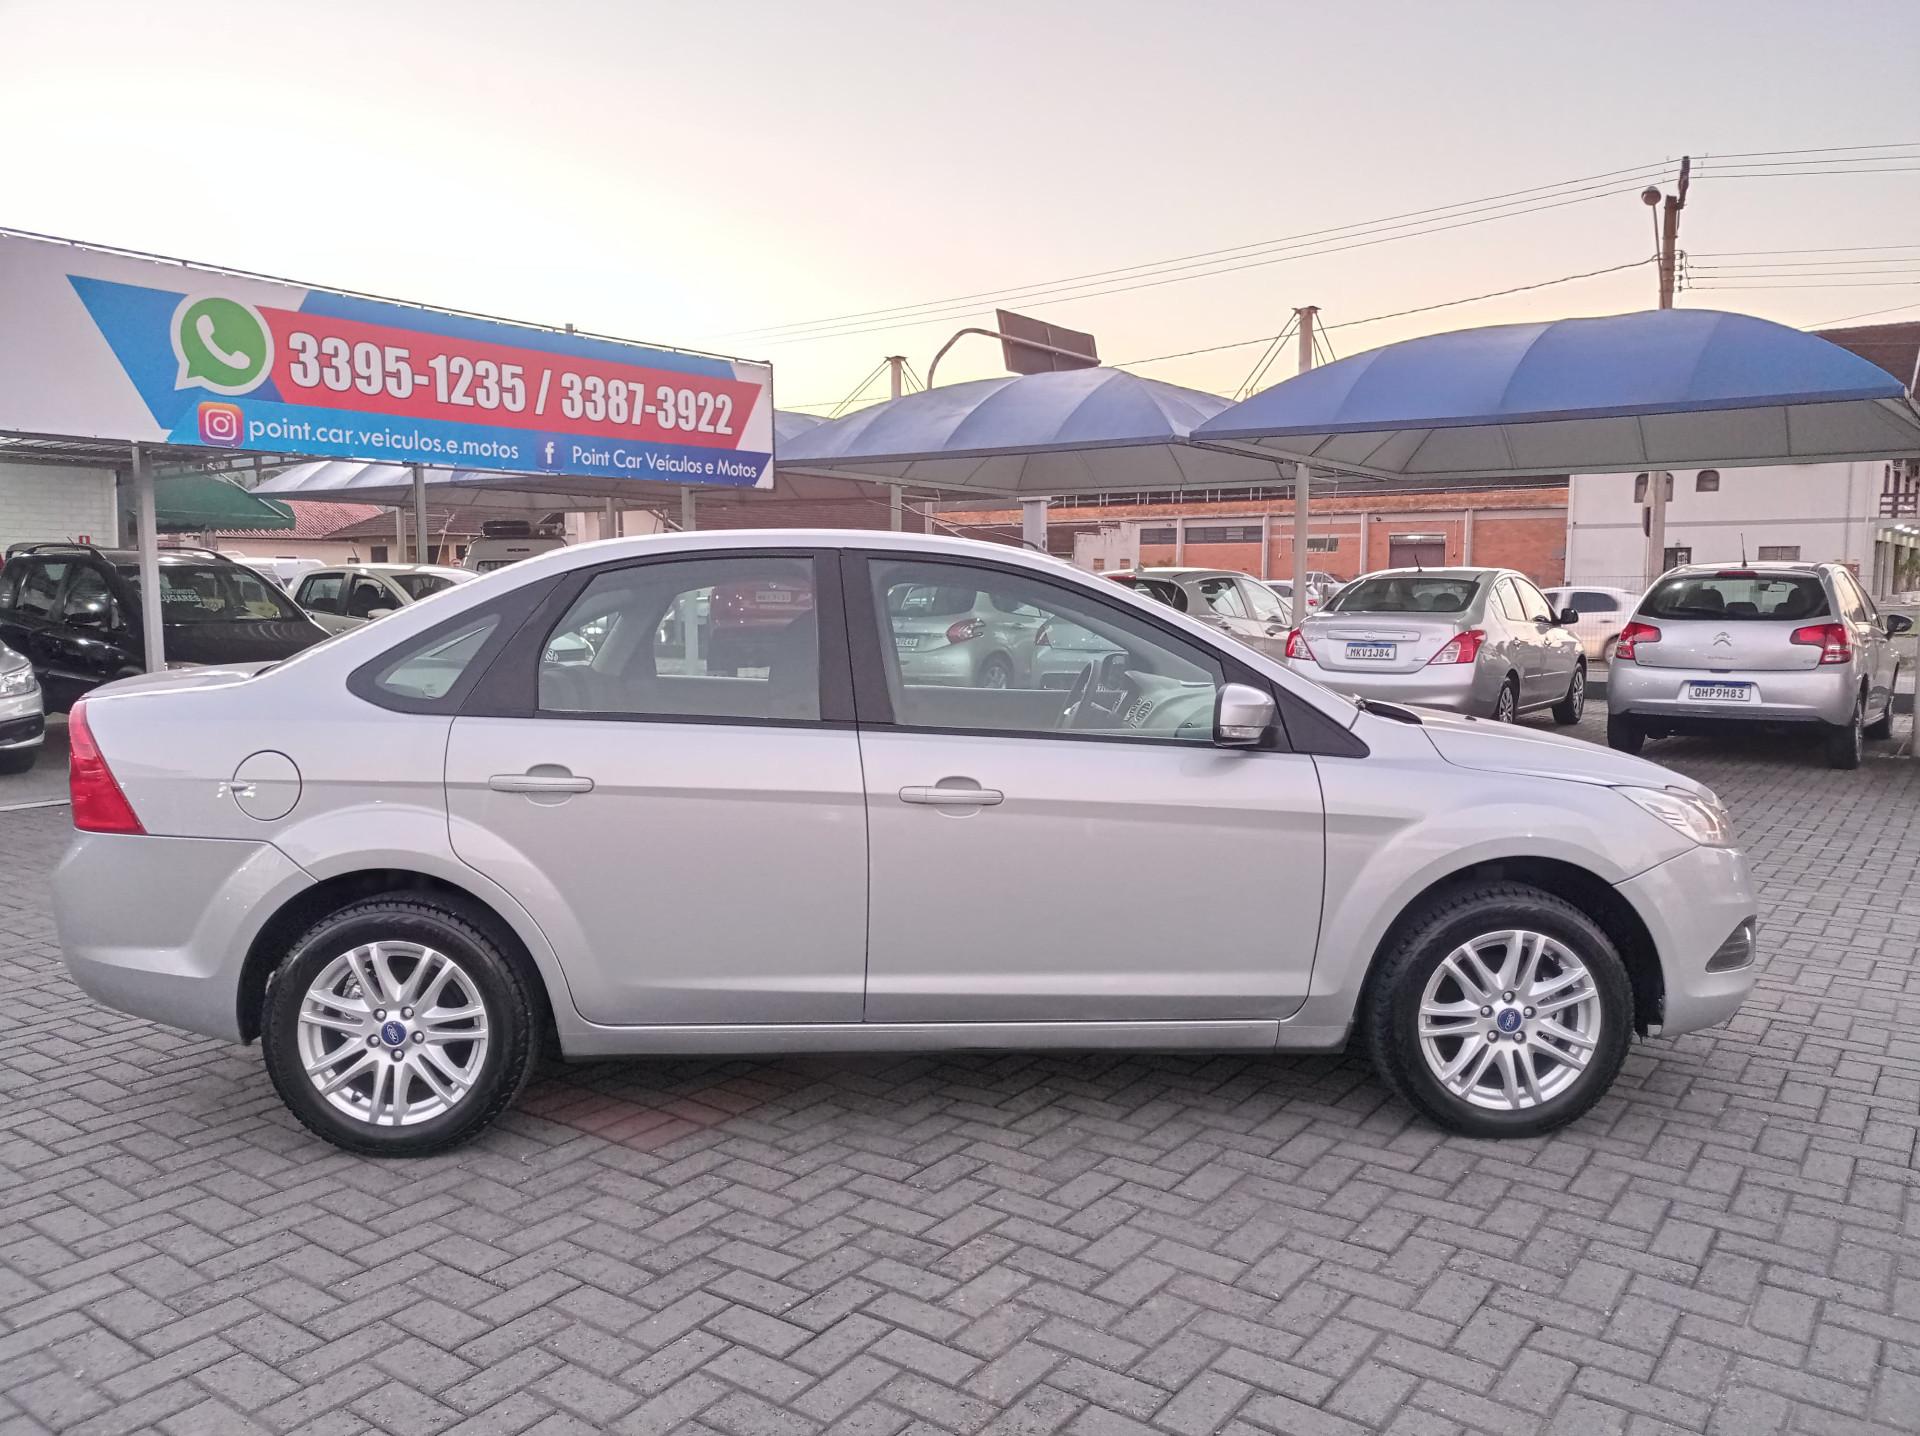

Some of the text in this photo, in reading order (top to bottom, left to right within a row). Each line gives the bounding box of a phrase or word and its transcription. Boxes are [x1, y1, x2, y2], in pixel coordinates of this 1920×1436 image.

[288, 332, 733, 435] 3395-1235 / 3387-3922
[248, 418, 519, 459] point.car.veiculos.e.motos
[572, 445, 610, 466] Point
[613, 449, 643, 469] Car
[646, 452, 703, 474] Veículos
[705, 463, 714, 475] e
[717, 459, 757, 478] Motos
[1350, 646, 1390, 658] MKV1J84
[1694, 686, 1745, 699] QHP9H83
